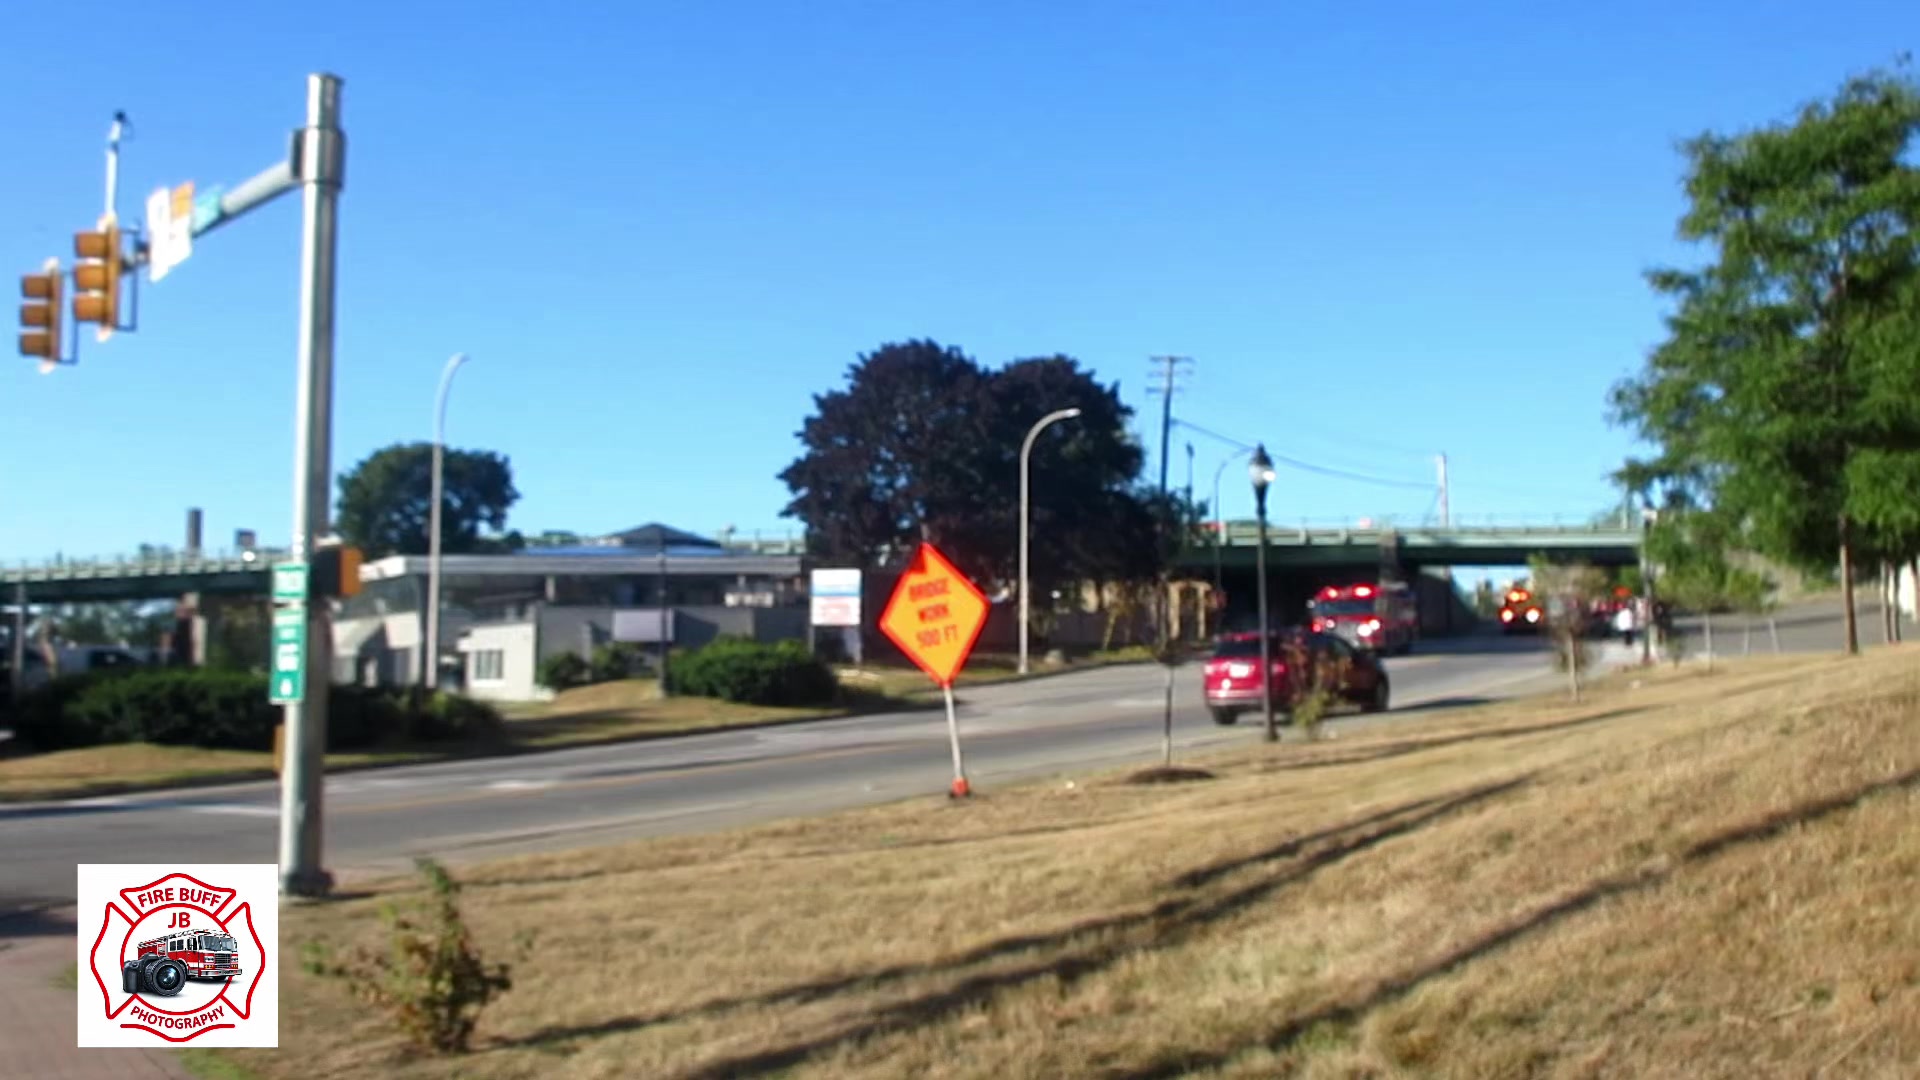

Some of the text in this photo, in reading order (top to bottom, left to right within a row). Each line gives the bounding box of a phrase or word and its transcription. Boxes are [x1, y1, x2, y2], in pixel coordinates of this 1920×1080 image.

[909, 577, 949, 602] BRIDGE
[918, 603, 950, 622] WORK
[916, 624, 958, 648] 500 FT
